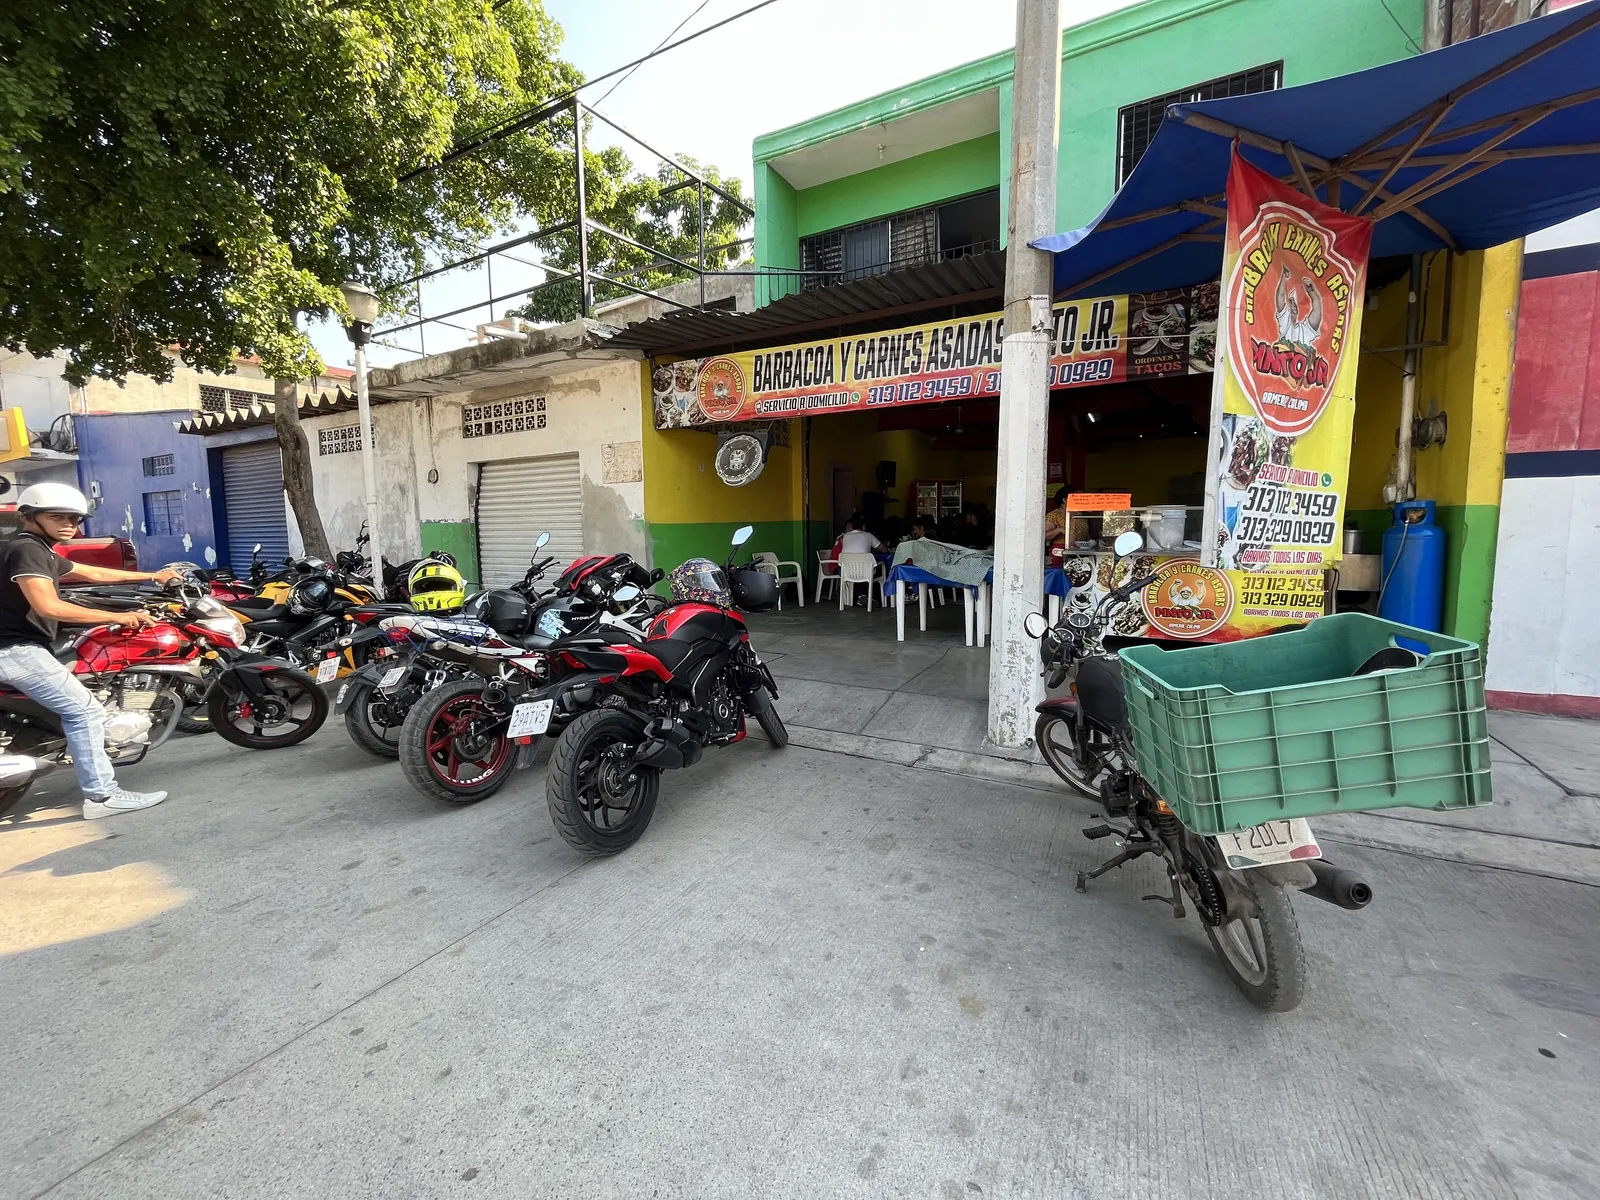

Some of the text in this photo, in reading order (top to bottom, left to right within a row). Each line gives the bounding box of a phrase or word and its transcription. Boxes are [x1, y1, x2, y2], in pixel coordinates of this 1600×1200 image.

[1081, 299, 1118, 352] JR.
[752, 343, 834, 393] BARBACOA
[840, 341, 852, 383] Y
[853, 330, 925, 381] CARNES
[925, 317, 1005, 372] ASADAS
[1134, 355, 1174, 365] ORDENES
[1059, 358, 1114, 384] 0929
[1134, 361, 1182, 375] TACOS
[763, 398, 798, 413] SERVICIO
[800, 396, 806, 409] A
[807, 392, 848, 409] DOMICILIO
[867, 386, 895, 405] 313
[898, 382, 920, 401] 112
[923, 376, 972, 399] 3459
[1242, 486, 1338, 517] 313 112 3459
[1236, 516, 1336, 544] 313 329 0929
[1242, 549, 1272, 563] ABRIMOS
[1272, 551, 1291, 564] TODOS
[1292, 551, 1306, 564] LOS
[1180, 564, 1214, 580] CARNES
[1210, 578, 1227, 608] ASADAS
[1241, 576, 1325, 592] 313 112 3459
[1240, 591, 1325, 608] 313 329 0929
[1154, 606, 1193, 620] PINTO
[1243, 608, 1269, 617] ABRIMOS
[1270, 609, 1290, 618] TODOS
[1291, 610, 1304, 618] LOS
